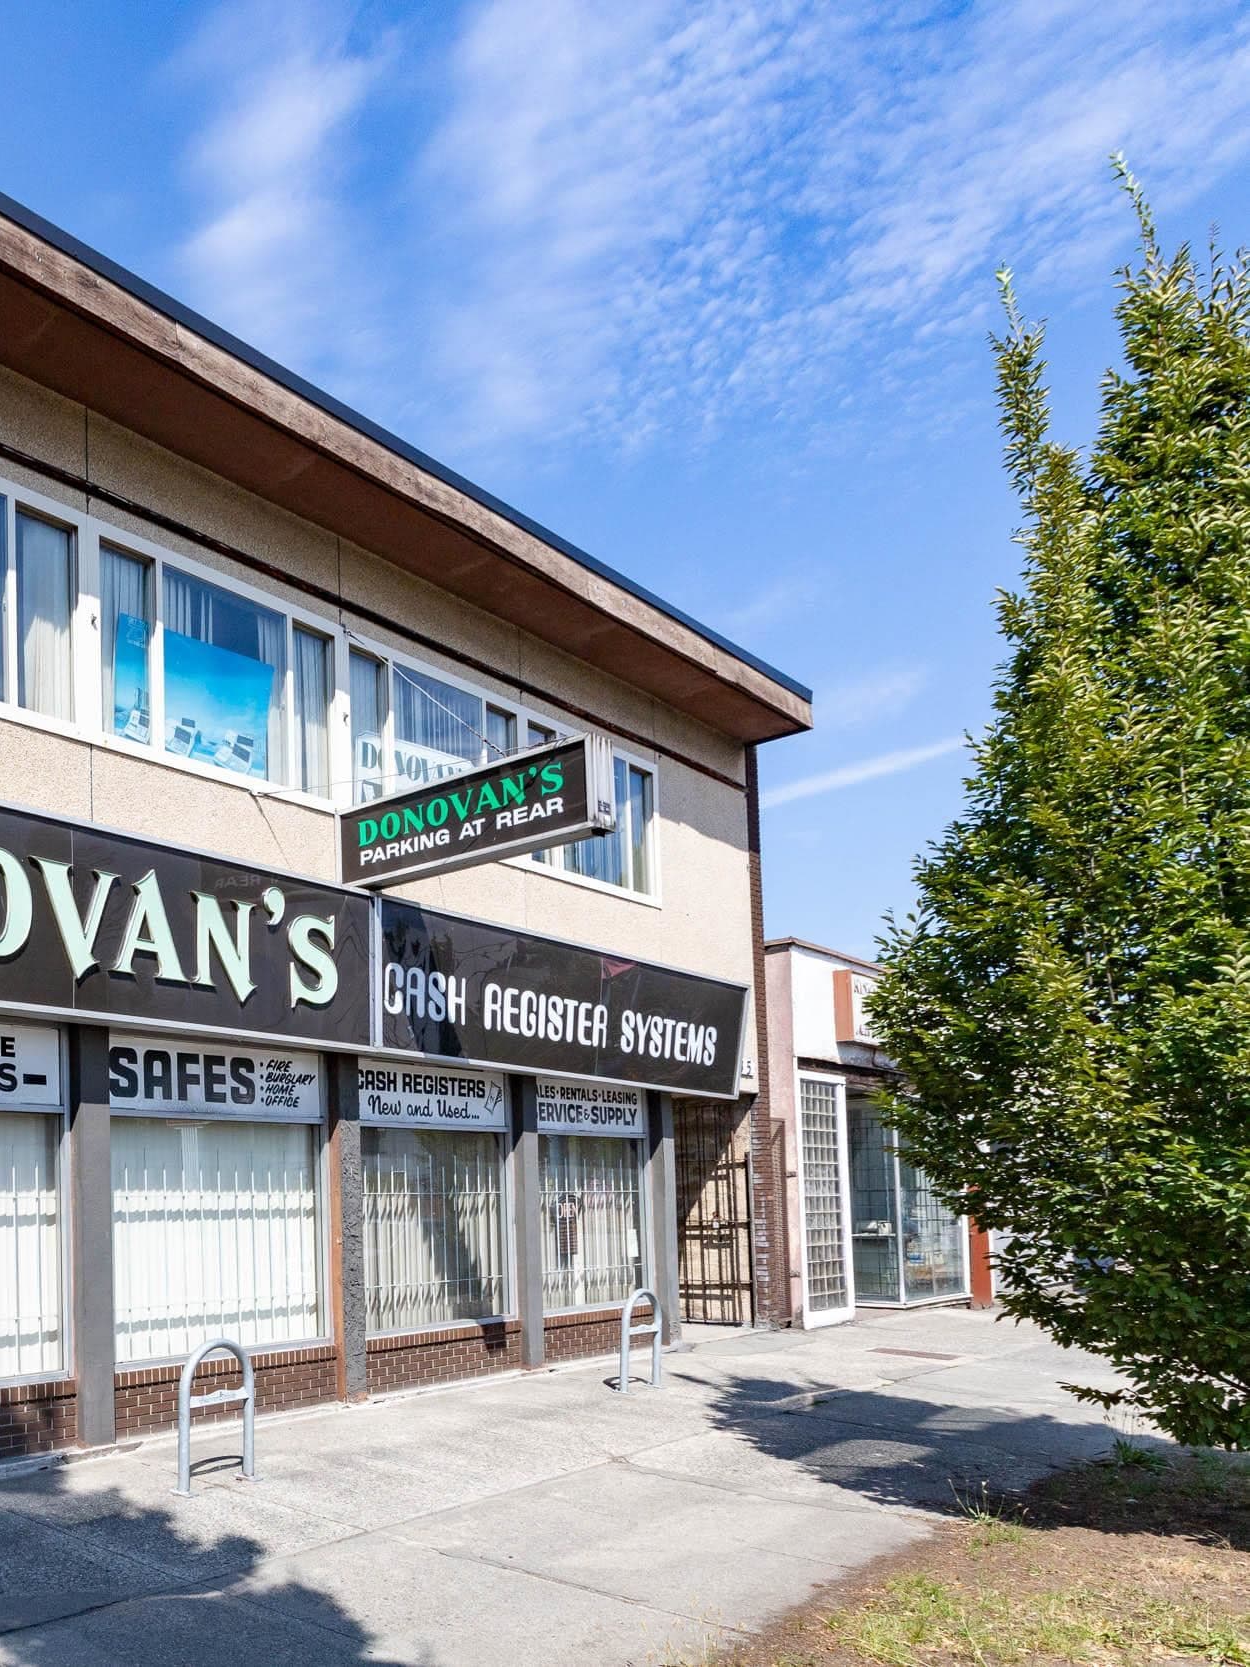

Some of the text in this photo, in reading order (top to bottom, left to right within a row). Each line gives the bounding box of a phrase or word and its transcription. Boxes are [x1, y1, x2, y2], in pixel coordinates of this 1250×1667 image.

[358, 761, 564, 847] DONOVAN'S
[360, 829, 450, 866] PARKING
[459, 818, 486, 840] AT
[496, 797, 564, 830] REAR
[383, 962, 718, 1066] CASH REGISTER SYSTEMS
[109, 1046, 256, 1105] SAFES
[266, 1059, 292, 1073] FIRE
[265, 1085, 296, 1096] HOME
[266, 1072, 316, 1086] BURGLARY
[402, 1073, 485, 1098] REGISTERS
[264, 1096, 300, 1108] OFFICE
[368, 1094, 402, 1116] New
[406, 1099, 433, 1117] and
[538, 1102, 583, 1123] ERVICE
